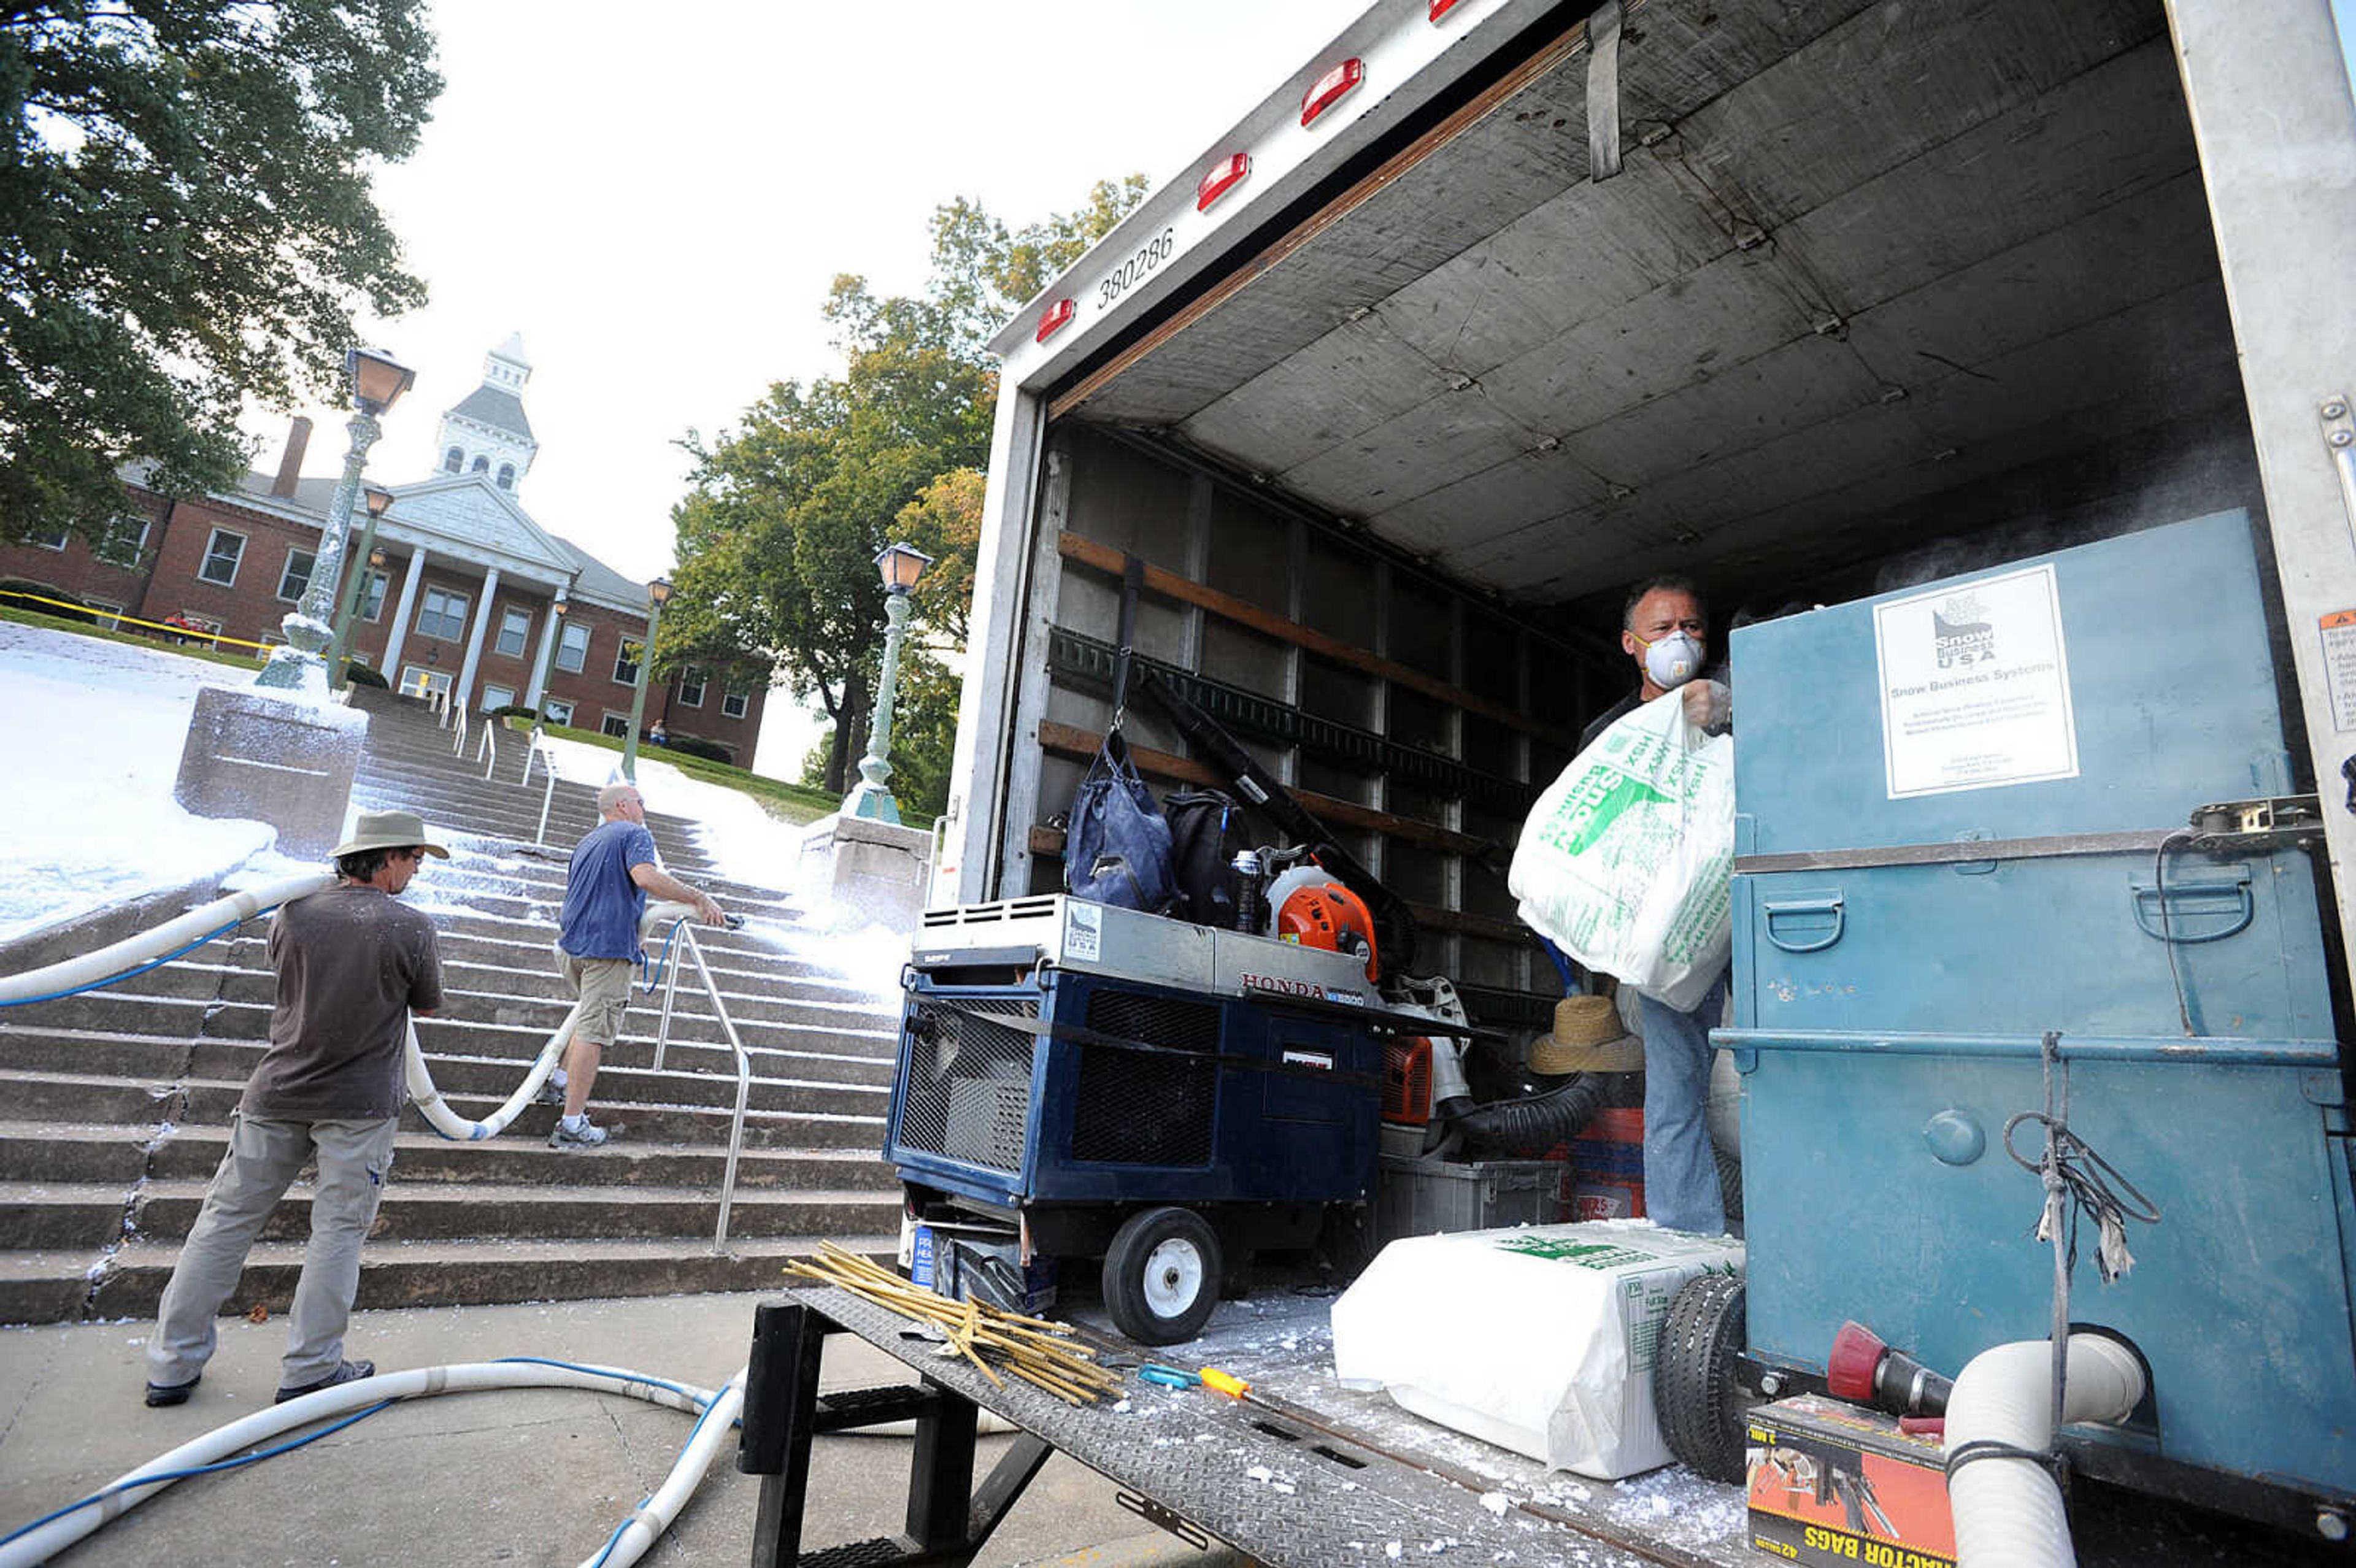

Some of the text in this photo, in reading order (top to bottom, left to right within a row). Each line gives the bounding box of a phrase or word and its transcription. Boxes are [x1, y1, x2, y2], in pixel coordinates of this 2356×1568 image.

[1098, 228, 1173, 309] 380286
[1935, 629, 1993, 648] Snow
[1890, 663, 2055, 698] Snow Business Systems
[1625, 736, 1653, 766] HSX
[1242, 973, 1326, 999] HONDA
[1749, 1427, 1768, 1443] MIL
[1769, 1432, 1777, 1446] 3
[1781, 1542, 1798, 1558] 42
[1804, 1526, 1859, 1559] BAGS
